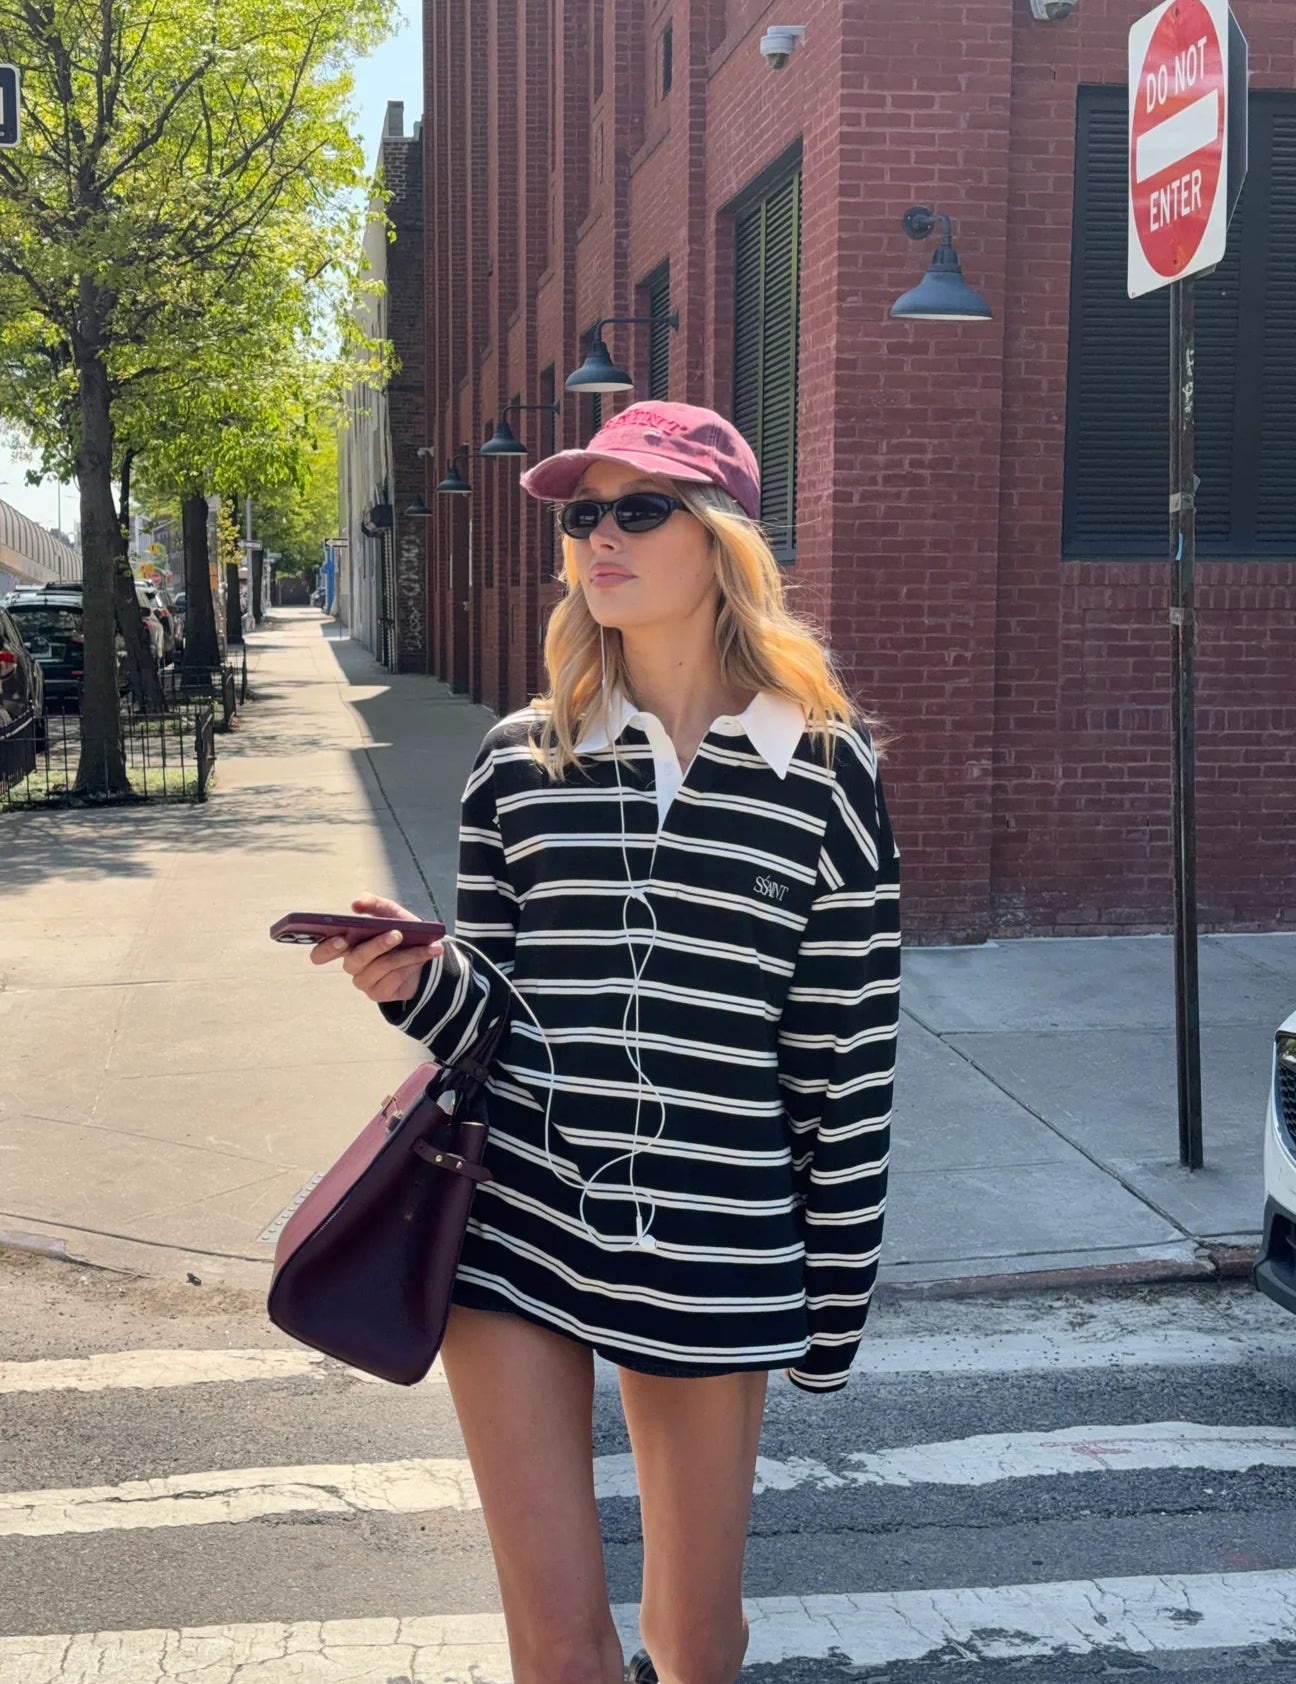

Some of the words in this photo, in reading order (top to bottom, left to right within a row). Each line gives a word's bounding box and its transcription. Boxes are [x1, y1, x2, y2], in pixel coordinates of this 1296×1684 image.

[1146, 64, 1168, 114] DO
[1175, 35, 1207, 96] NOT
[1150, 168, 1202, 233] ENTER
